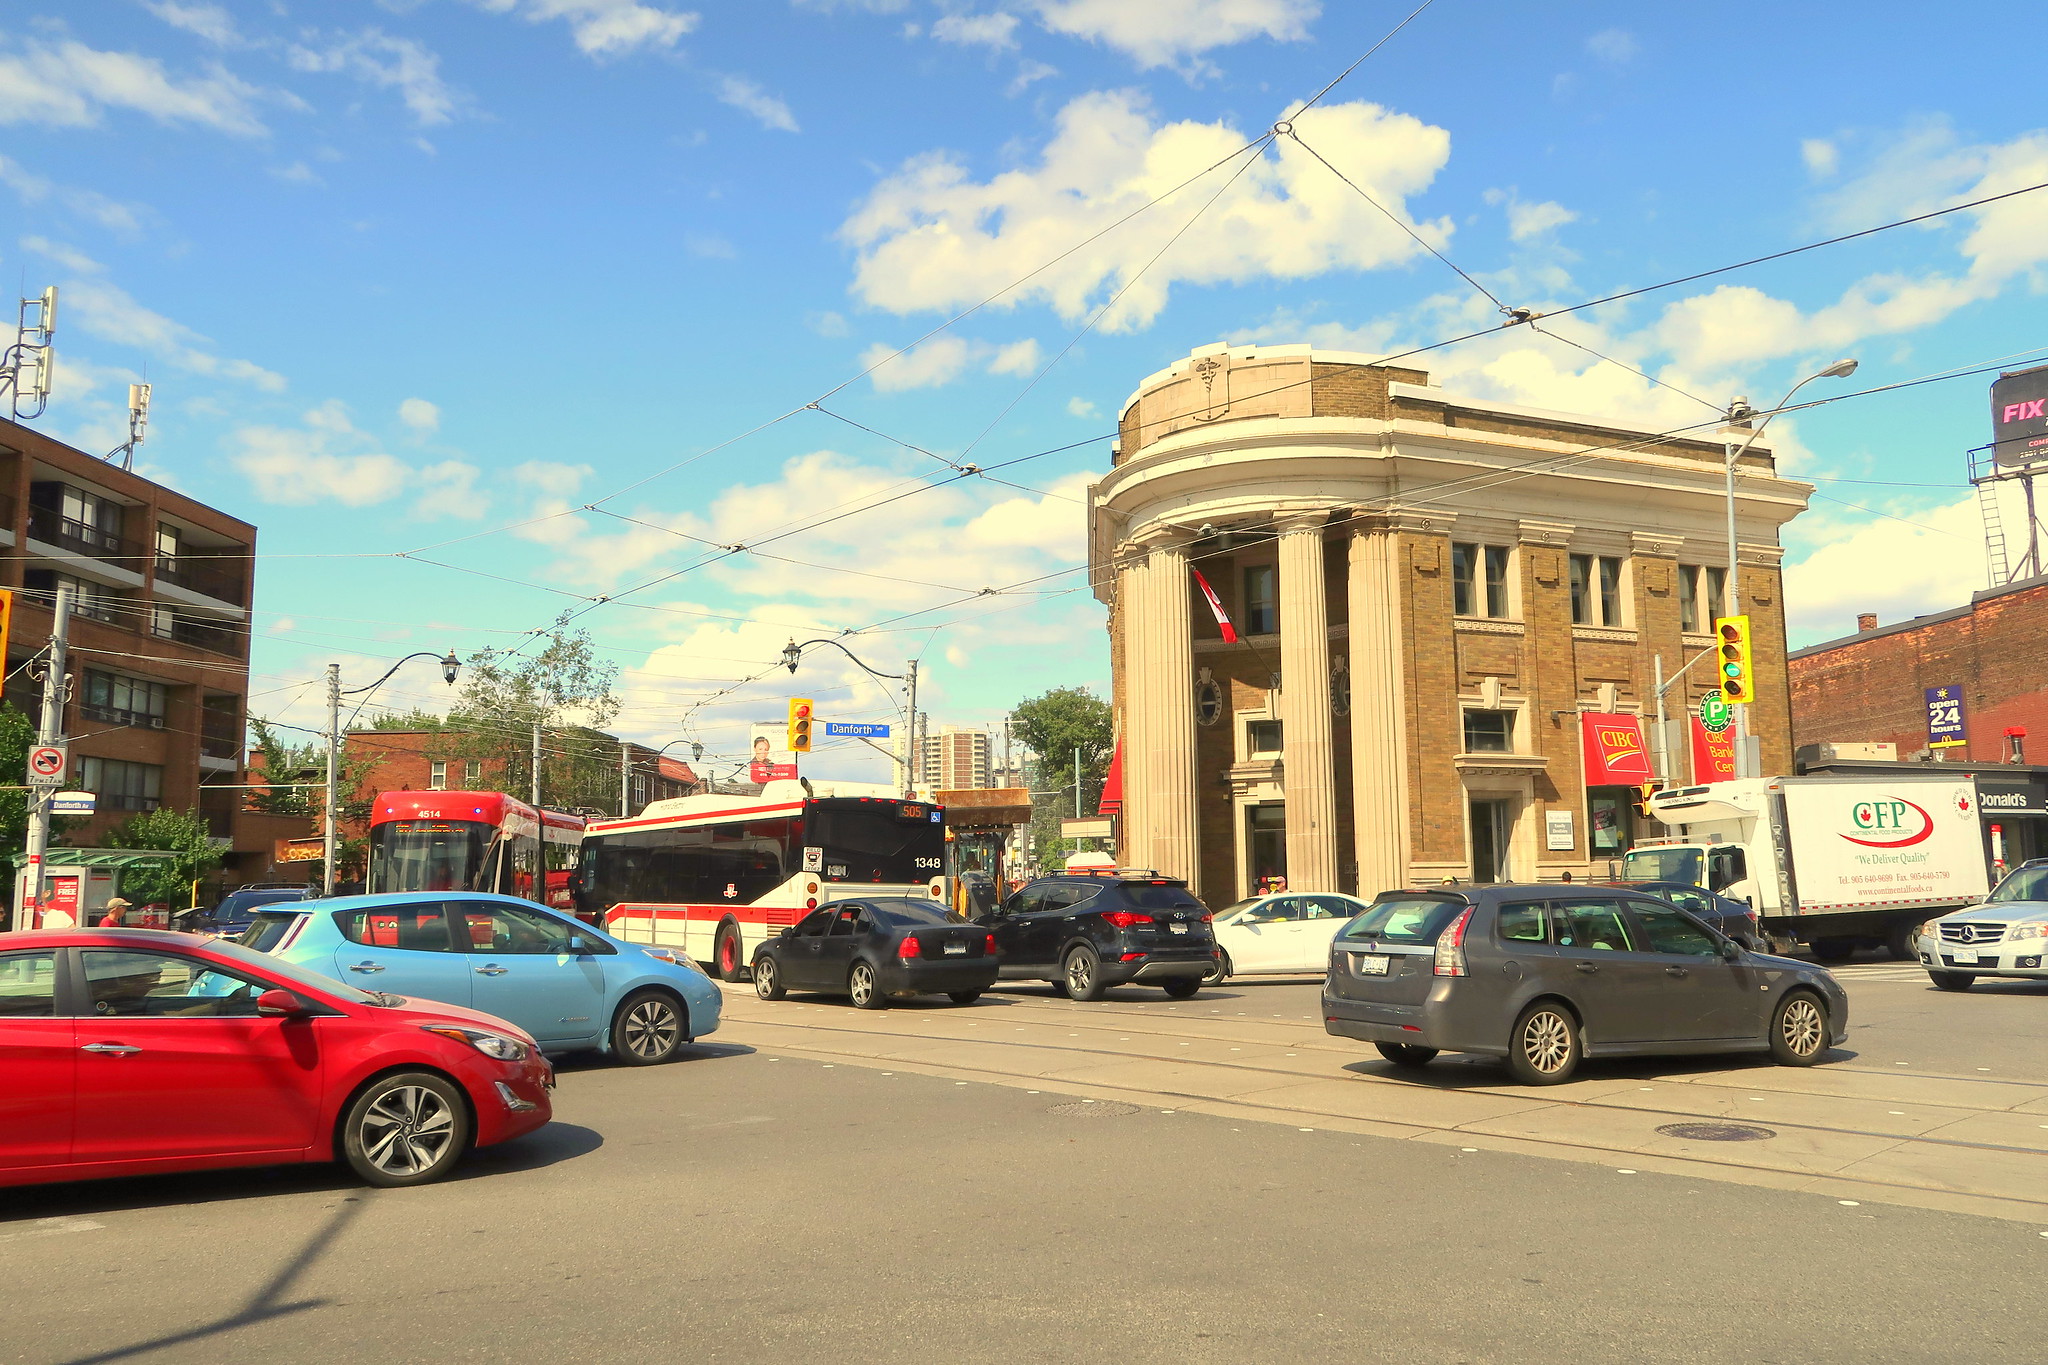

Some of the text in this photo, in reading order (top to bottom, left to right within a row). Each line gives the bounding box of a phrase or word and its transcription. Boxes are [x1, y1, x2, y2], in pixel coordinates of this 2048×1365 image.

[2003, 398, 2046, 423] FIX
[1710, 701, 1724, 718] P
[1929, 700, 1959, 710] open
[1929, 707, 1961, 726] 24
[832, 724, 873, 734] Danforth
[1930, 725, 1962, 733] hours
[1601, 730, 1639, 748] CIBC
[1704, 731, 1729, 744] CIBC
[53, 801, 81, 809] Danforth
[417, 810, 441, 818] 4514
[903, 805, 922, 818] 505
[1852, 801, 1906, 829] CFP
[914, 857, 941, 869] 1348
[1872, 853, 1899, 865] Deliver
[1850, 875, 1864, 884] 905
